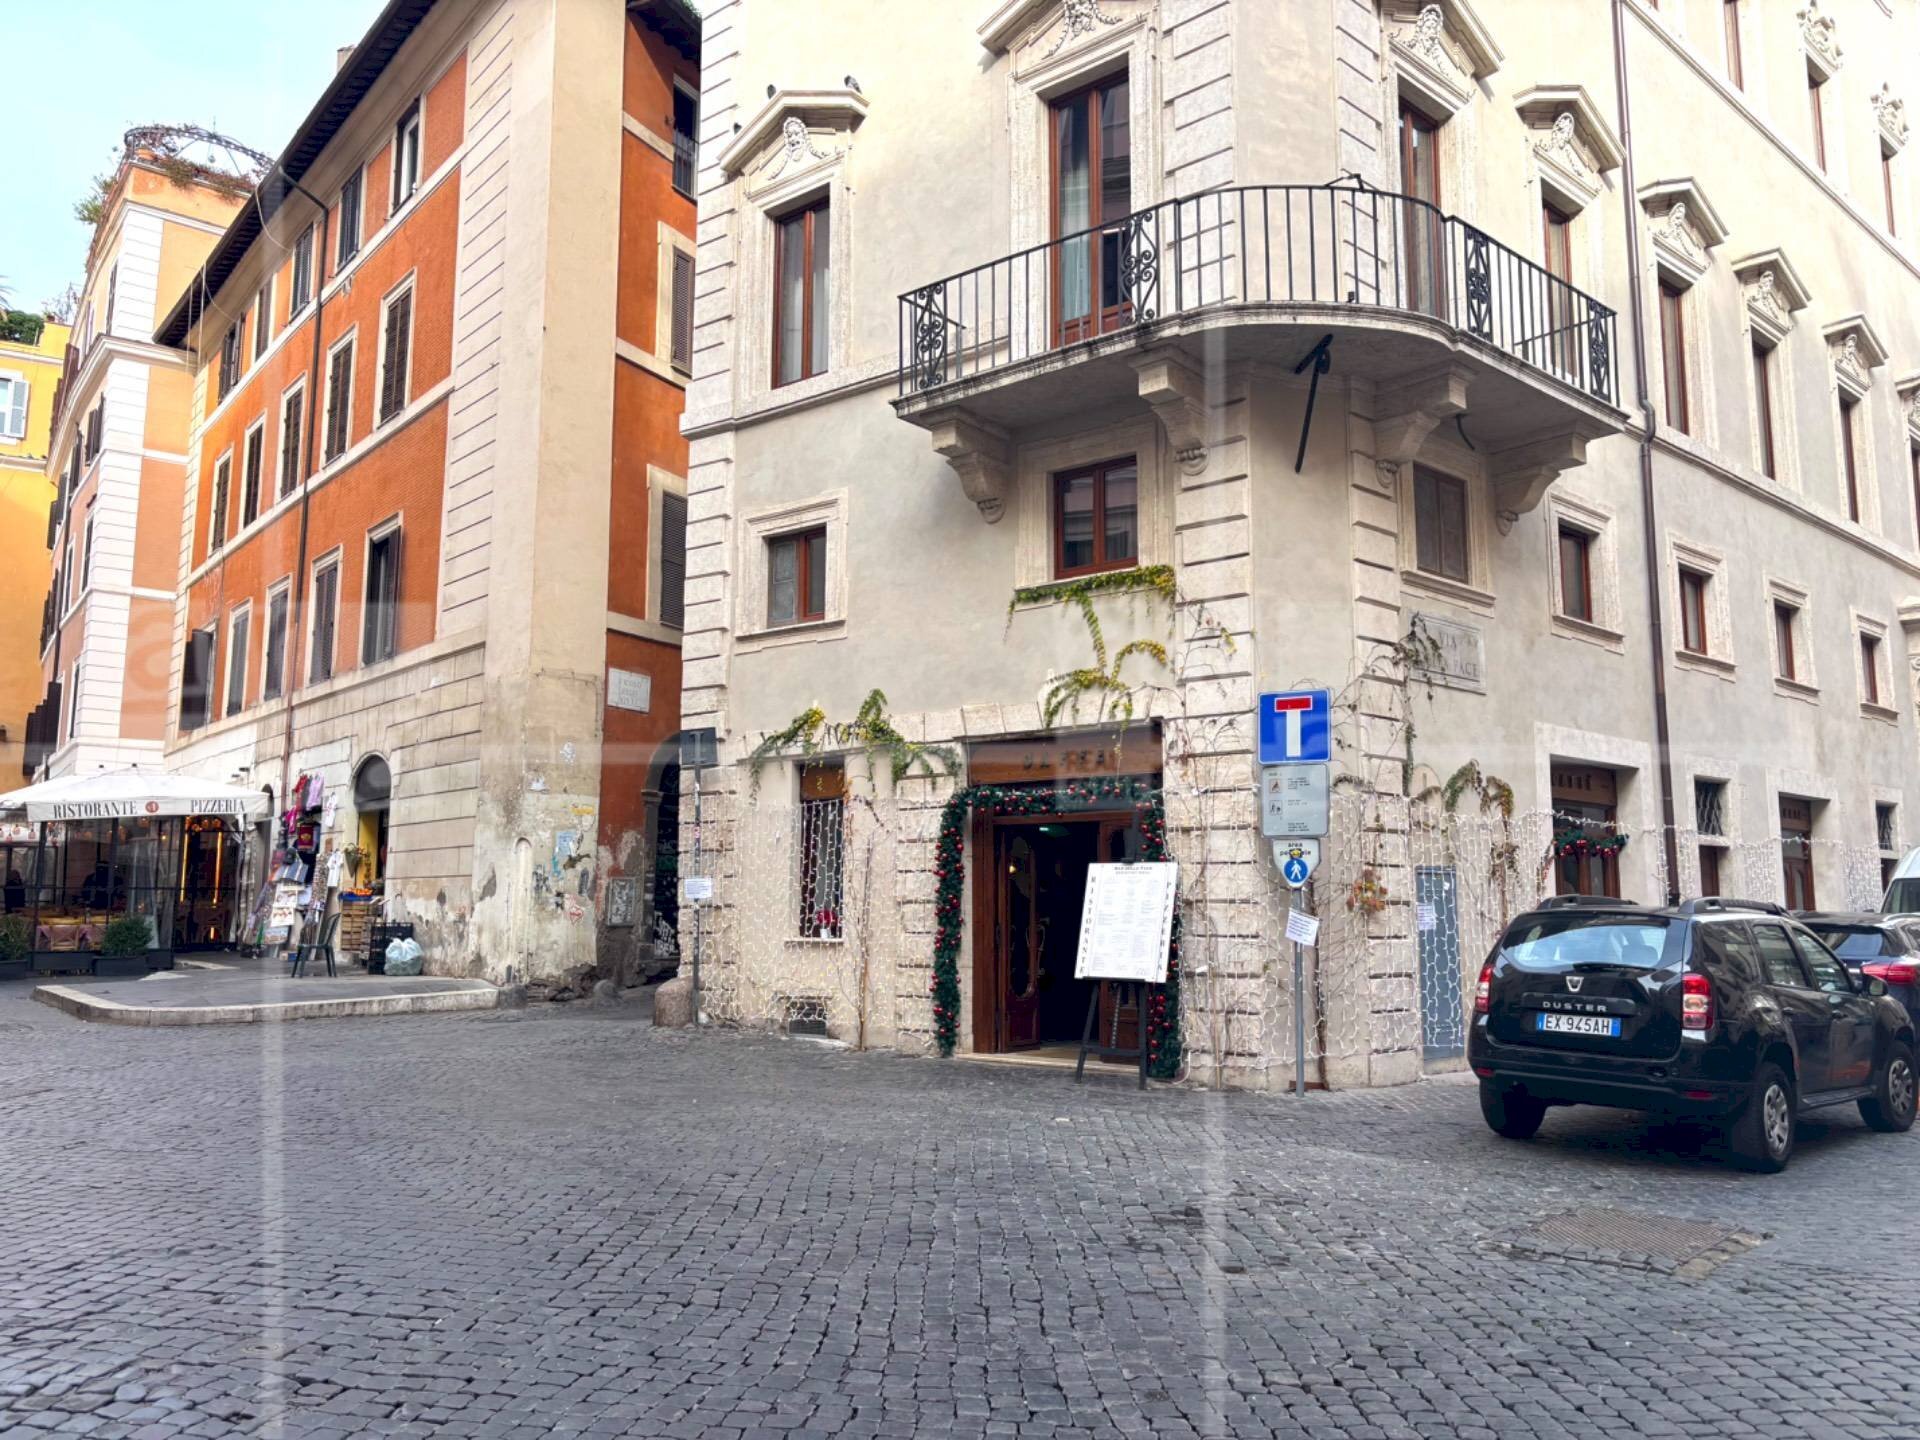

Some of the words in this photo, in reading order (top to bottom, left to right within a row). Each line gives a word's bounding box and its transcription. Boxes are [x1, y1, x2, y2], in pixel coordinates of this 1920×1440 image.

[54, 801, 137, 818] RISTORANTE
[190, 798, 246, 815] PIZZERIA
[1543, 1001, 1607, 1012] DUSTER
[1545, 1014, 1563, 1031] EX
[1566, 1017, 1611, 1034] 945AH
